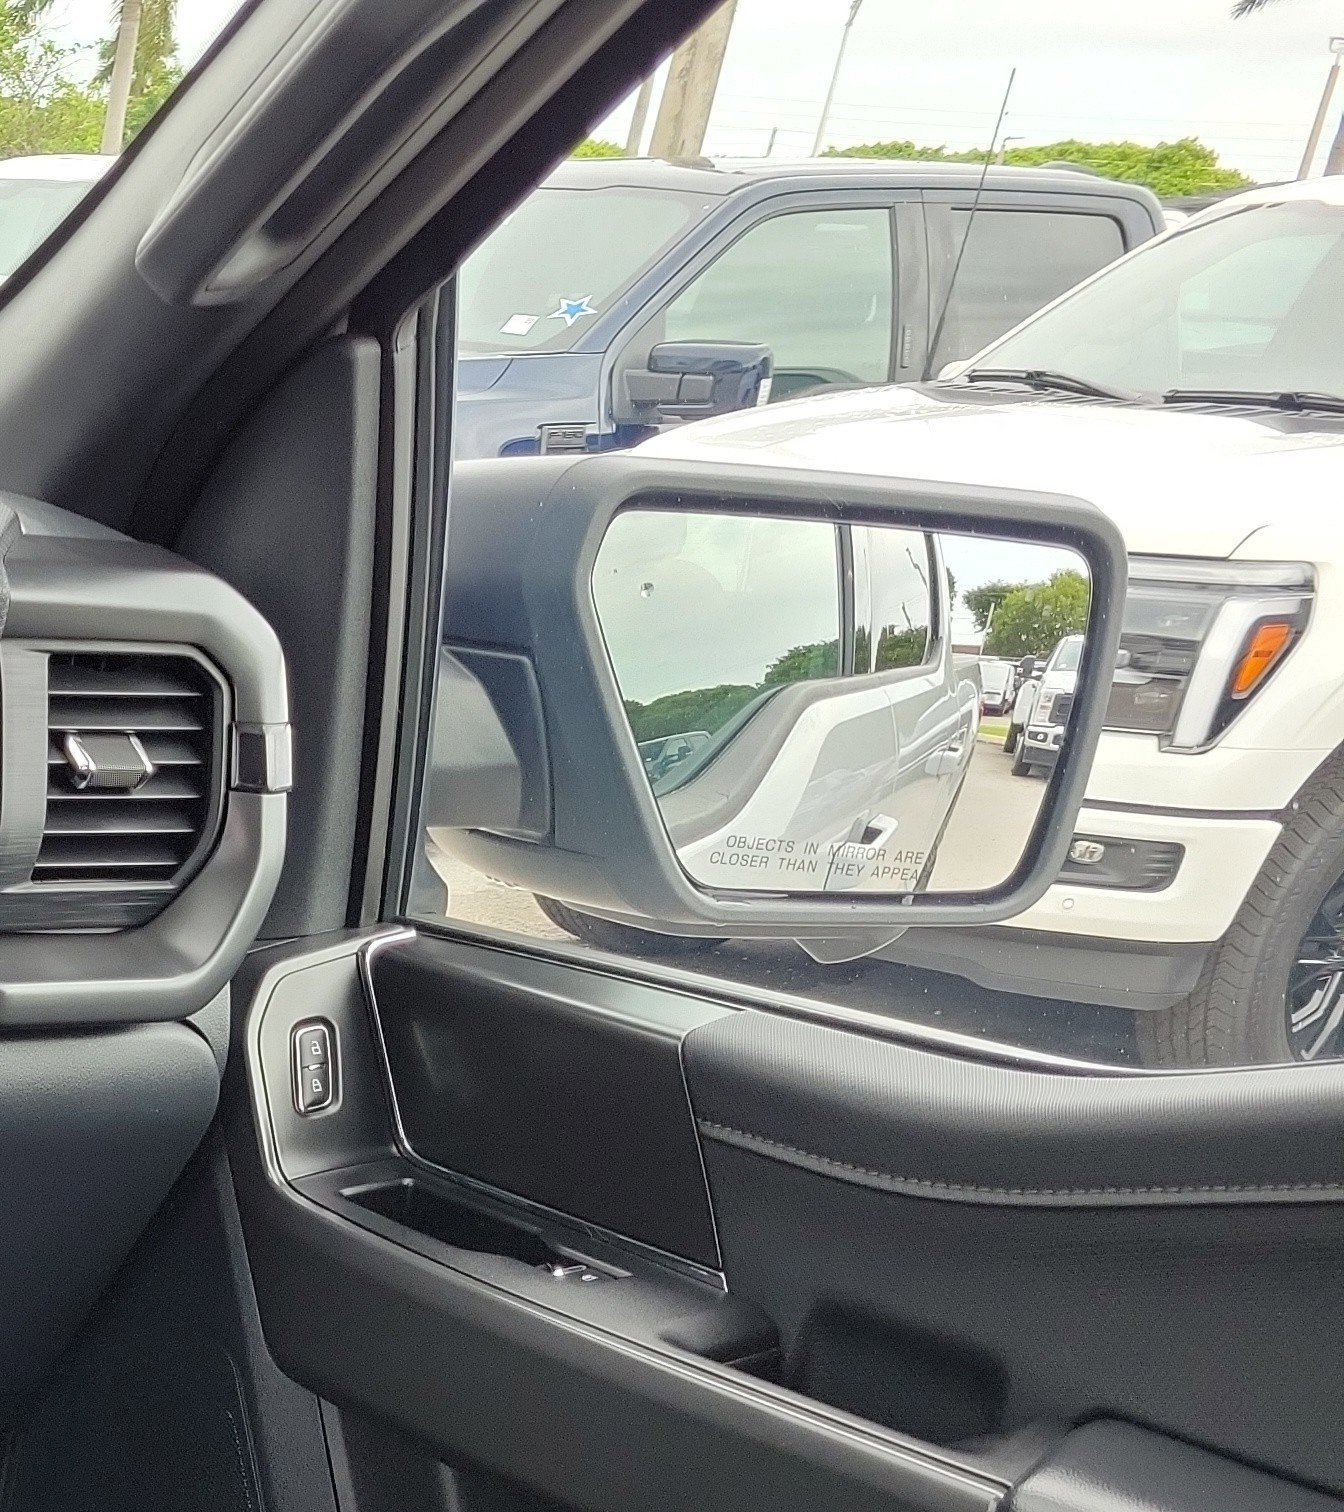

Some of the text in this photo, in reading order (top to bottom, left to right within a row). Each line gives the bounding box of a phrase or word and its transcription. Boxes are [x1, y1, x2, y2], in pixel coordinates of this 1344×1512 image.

[726, 835, 924, 865] OBJECTS IN MIRROR ARE
[709, 851, 924, 882] CLOSER THAN THEY APPEA
